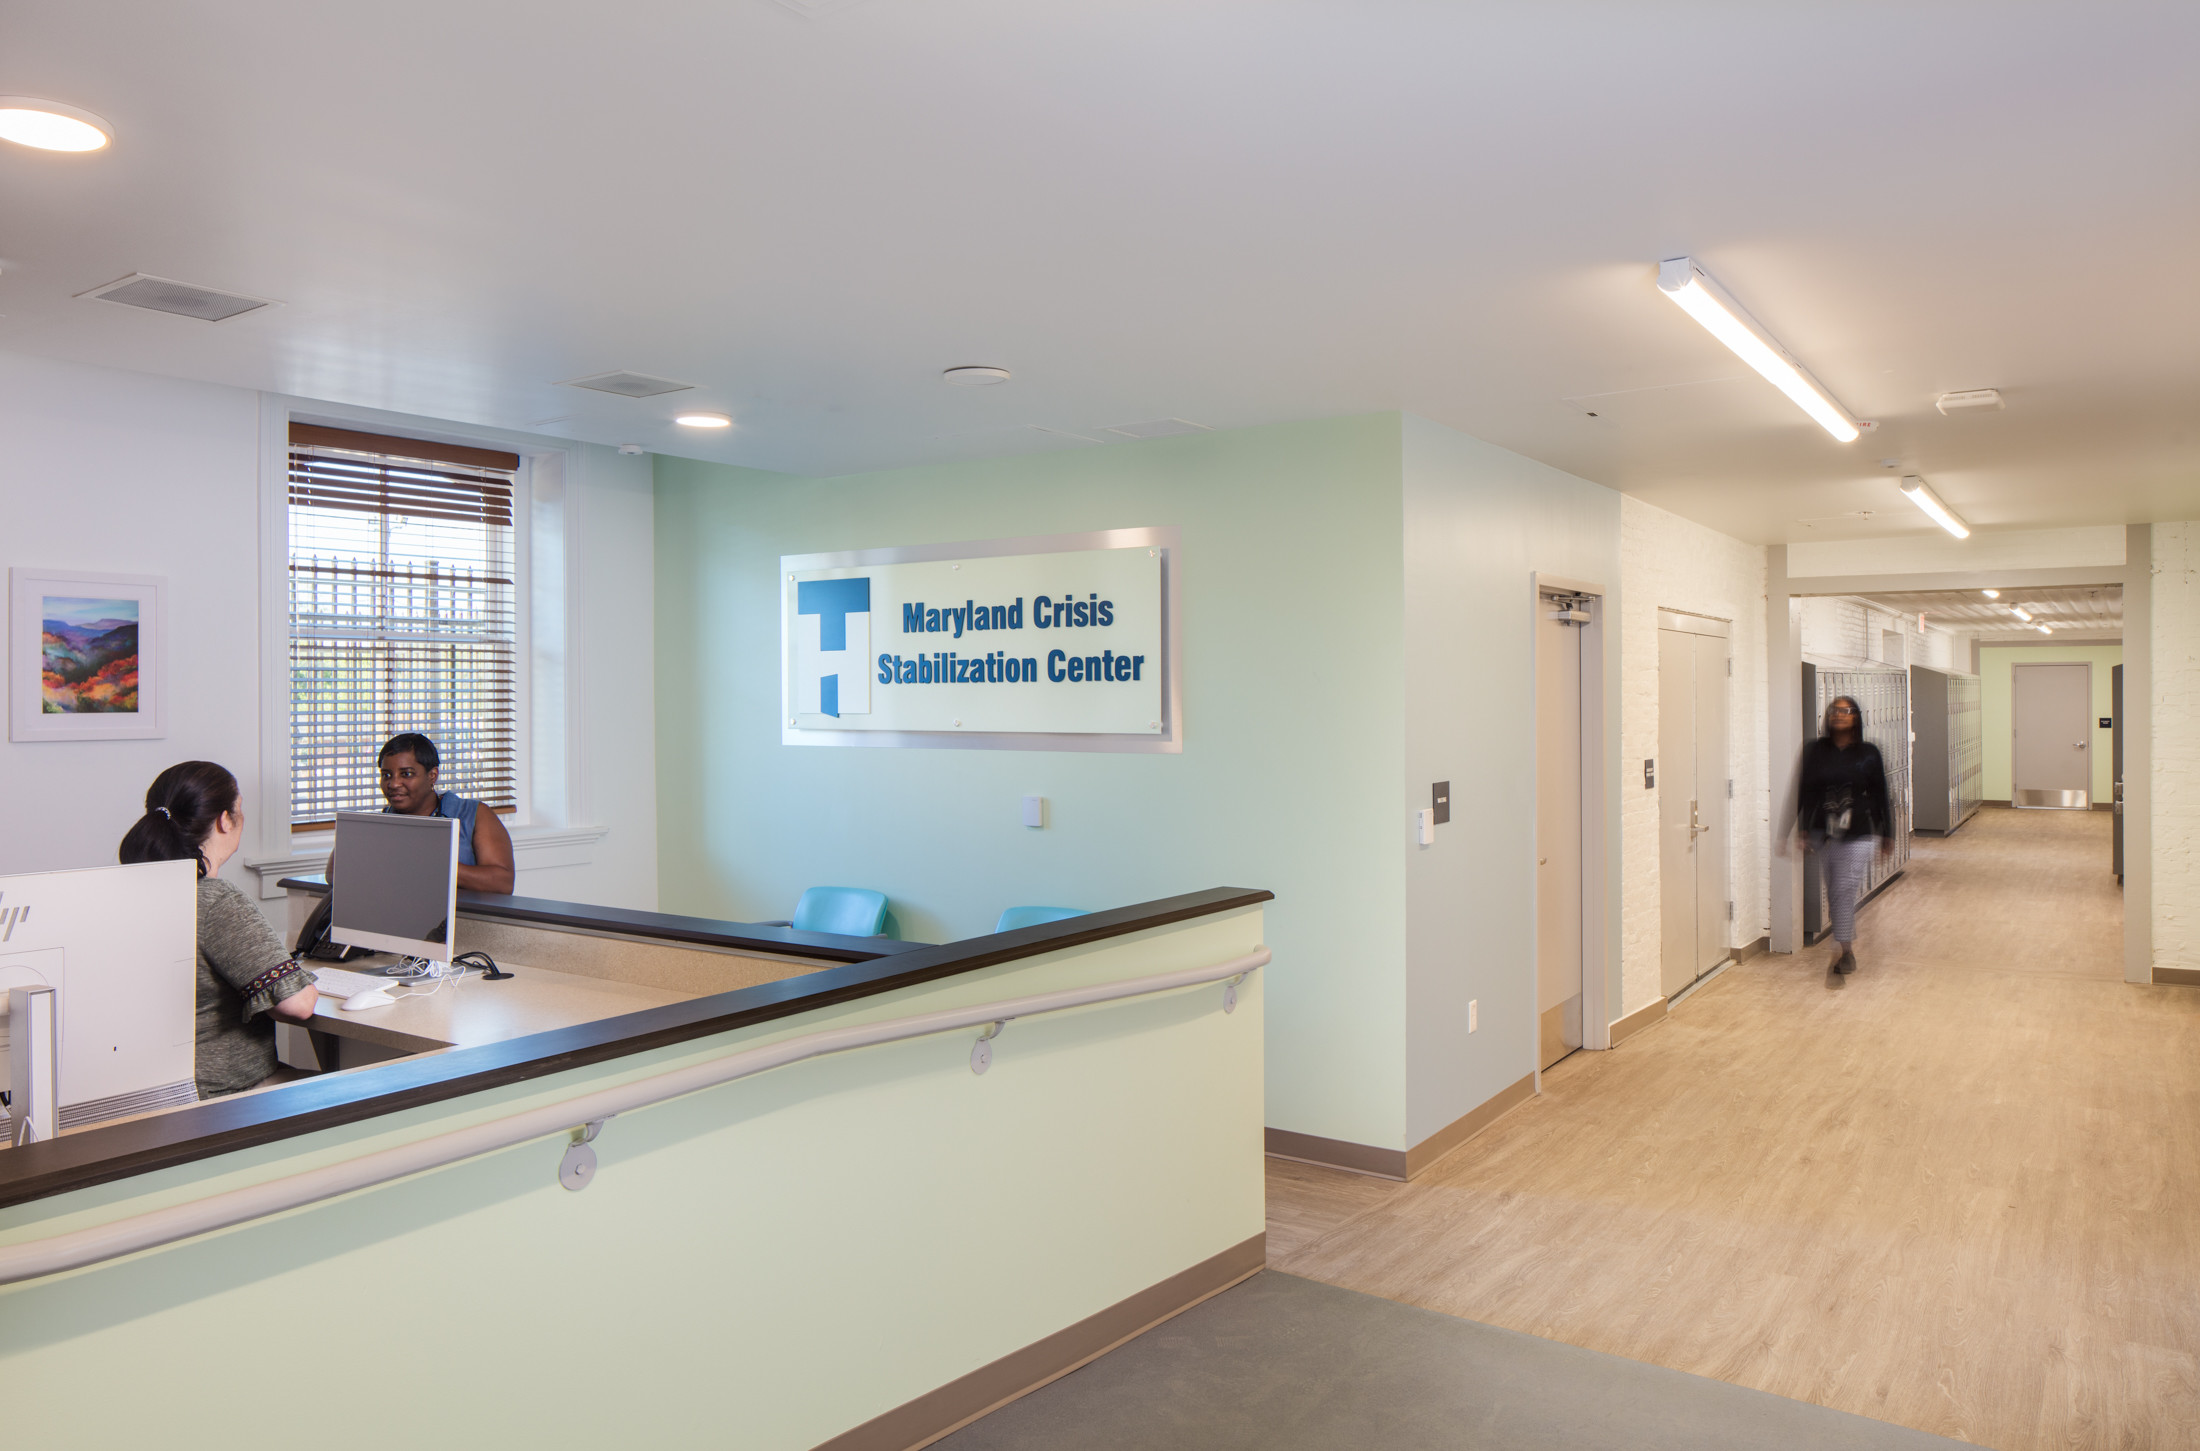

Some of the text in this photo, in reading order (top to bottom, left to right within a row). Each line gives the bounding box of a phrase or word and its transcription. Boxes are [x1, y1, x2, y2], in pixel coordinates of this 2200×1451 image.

[902, 593, 1114, 639] Maryland Crisis
[878, 649, 1145, 684] Stabilization Center
